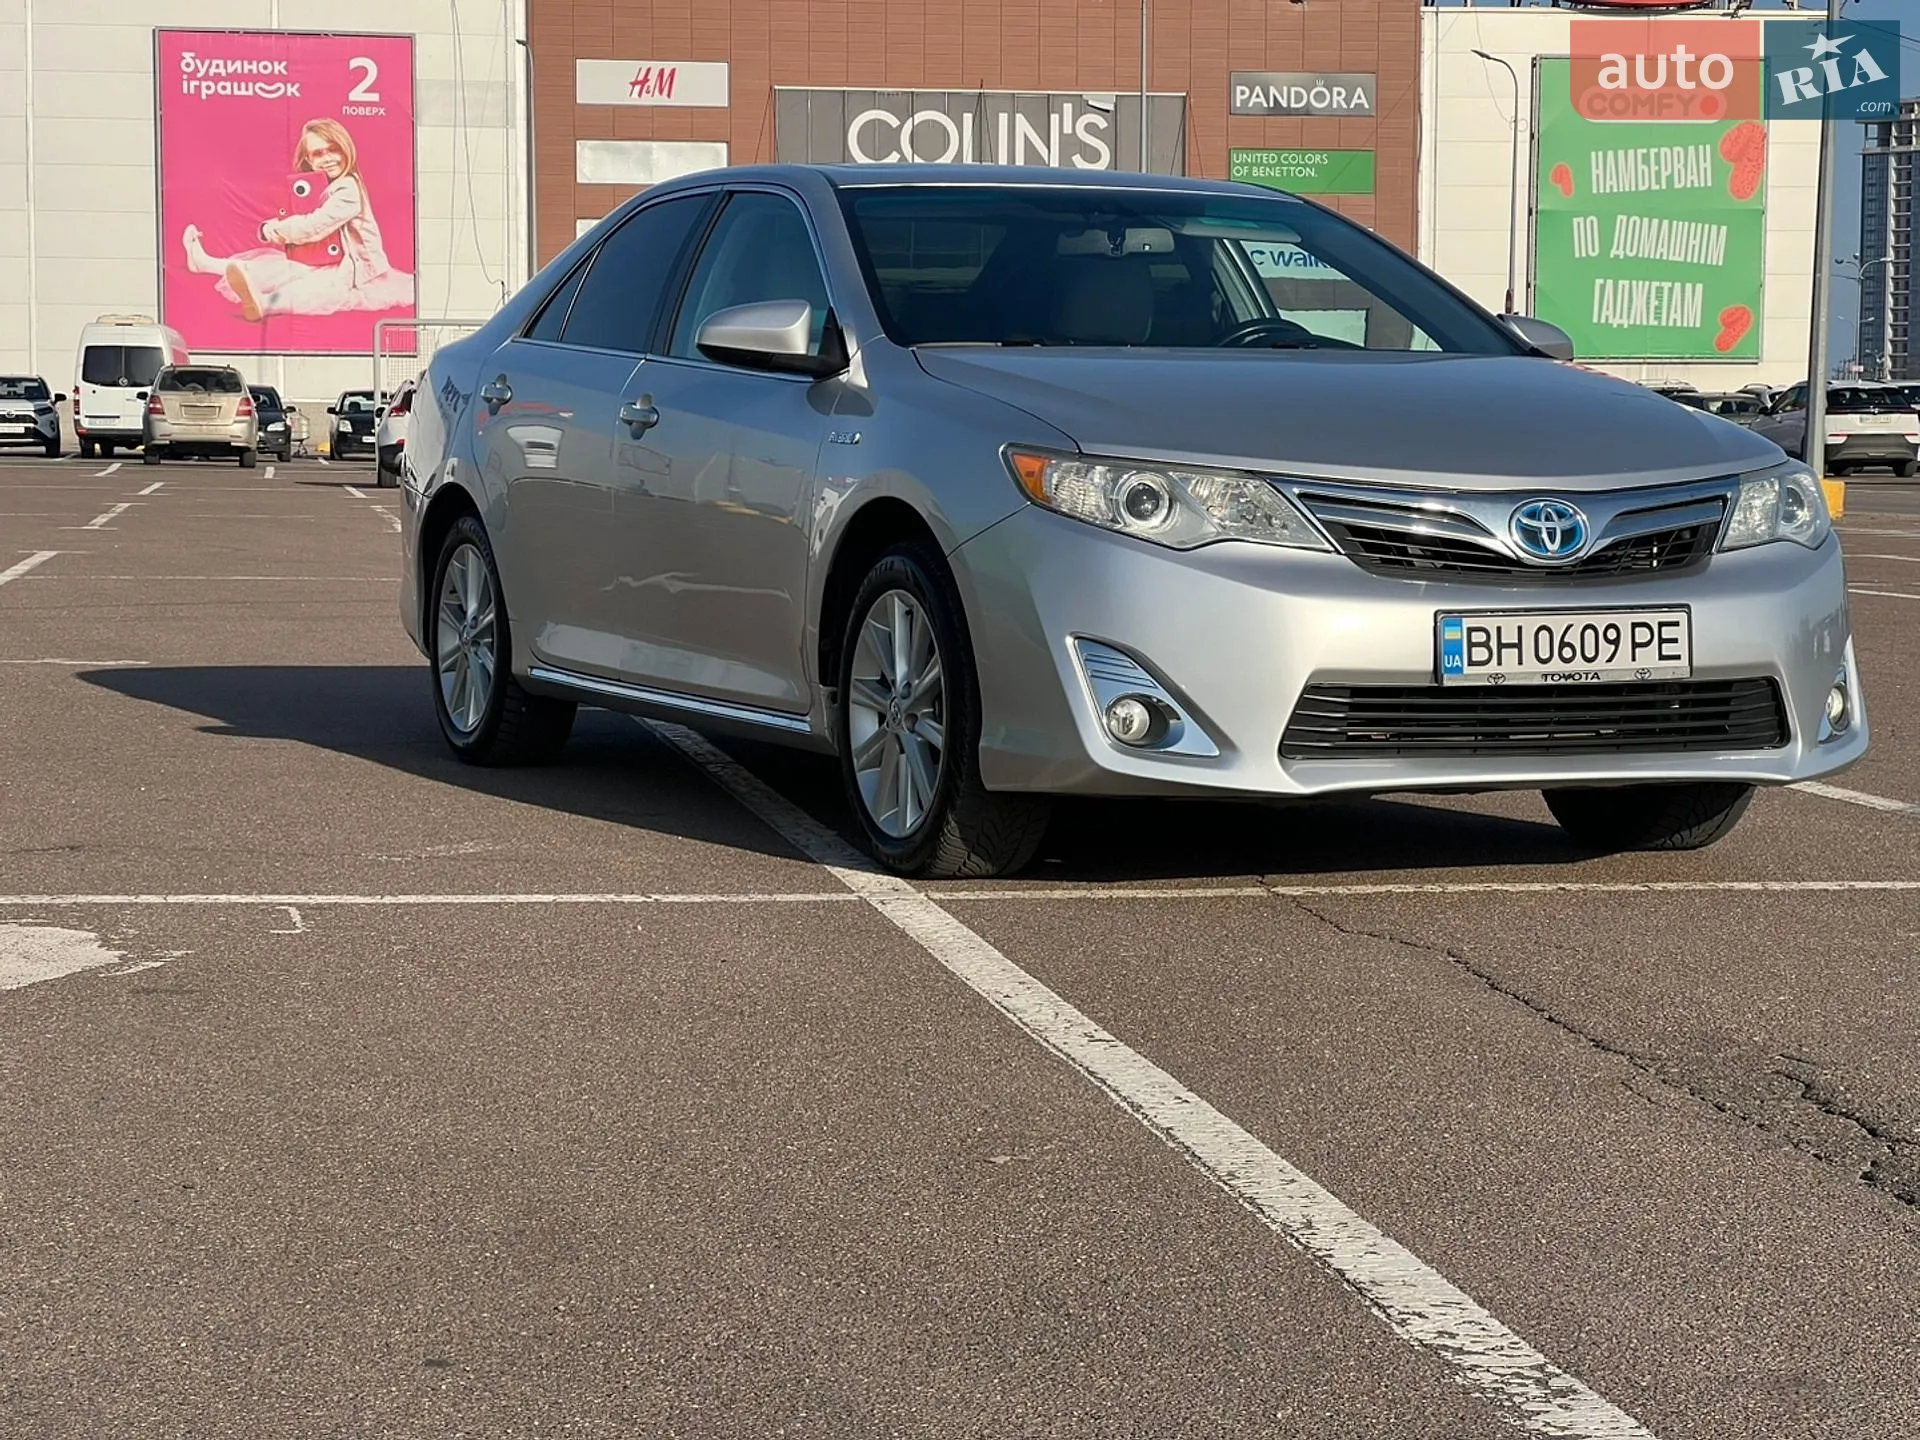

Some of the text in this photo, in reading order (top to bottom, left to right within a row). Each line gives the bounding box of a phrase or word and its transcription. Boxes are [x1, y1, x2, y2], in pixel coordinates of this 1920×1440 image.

[180, 51, 288, 77] будинок
[348, 56, 380, 102] 2
[629, 66, 677, 99] H&M
[1235, 79, 1370, 109] PANDORA
[342, 106, 386, 116] ПОВЕРХ
[847, 102, 1111, 169] COLIN'S
[1233, 153, 1328, 165] UNITED COLORS
[1233, 166, 1249, 177] OF
[1591, 144, 1712, 194] НАМБЕРВАН
[1572, 214, 1728, 266] ПО ДОМАШНІМ
[1592, 278, 1703, 328] ГАДЖЕТАМ
[1466, 621, 1682, 667] BH 0609 PE
[1444, 655, 1462, 668] UA
[1541, 671, 1601, 683] TOYOTA
